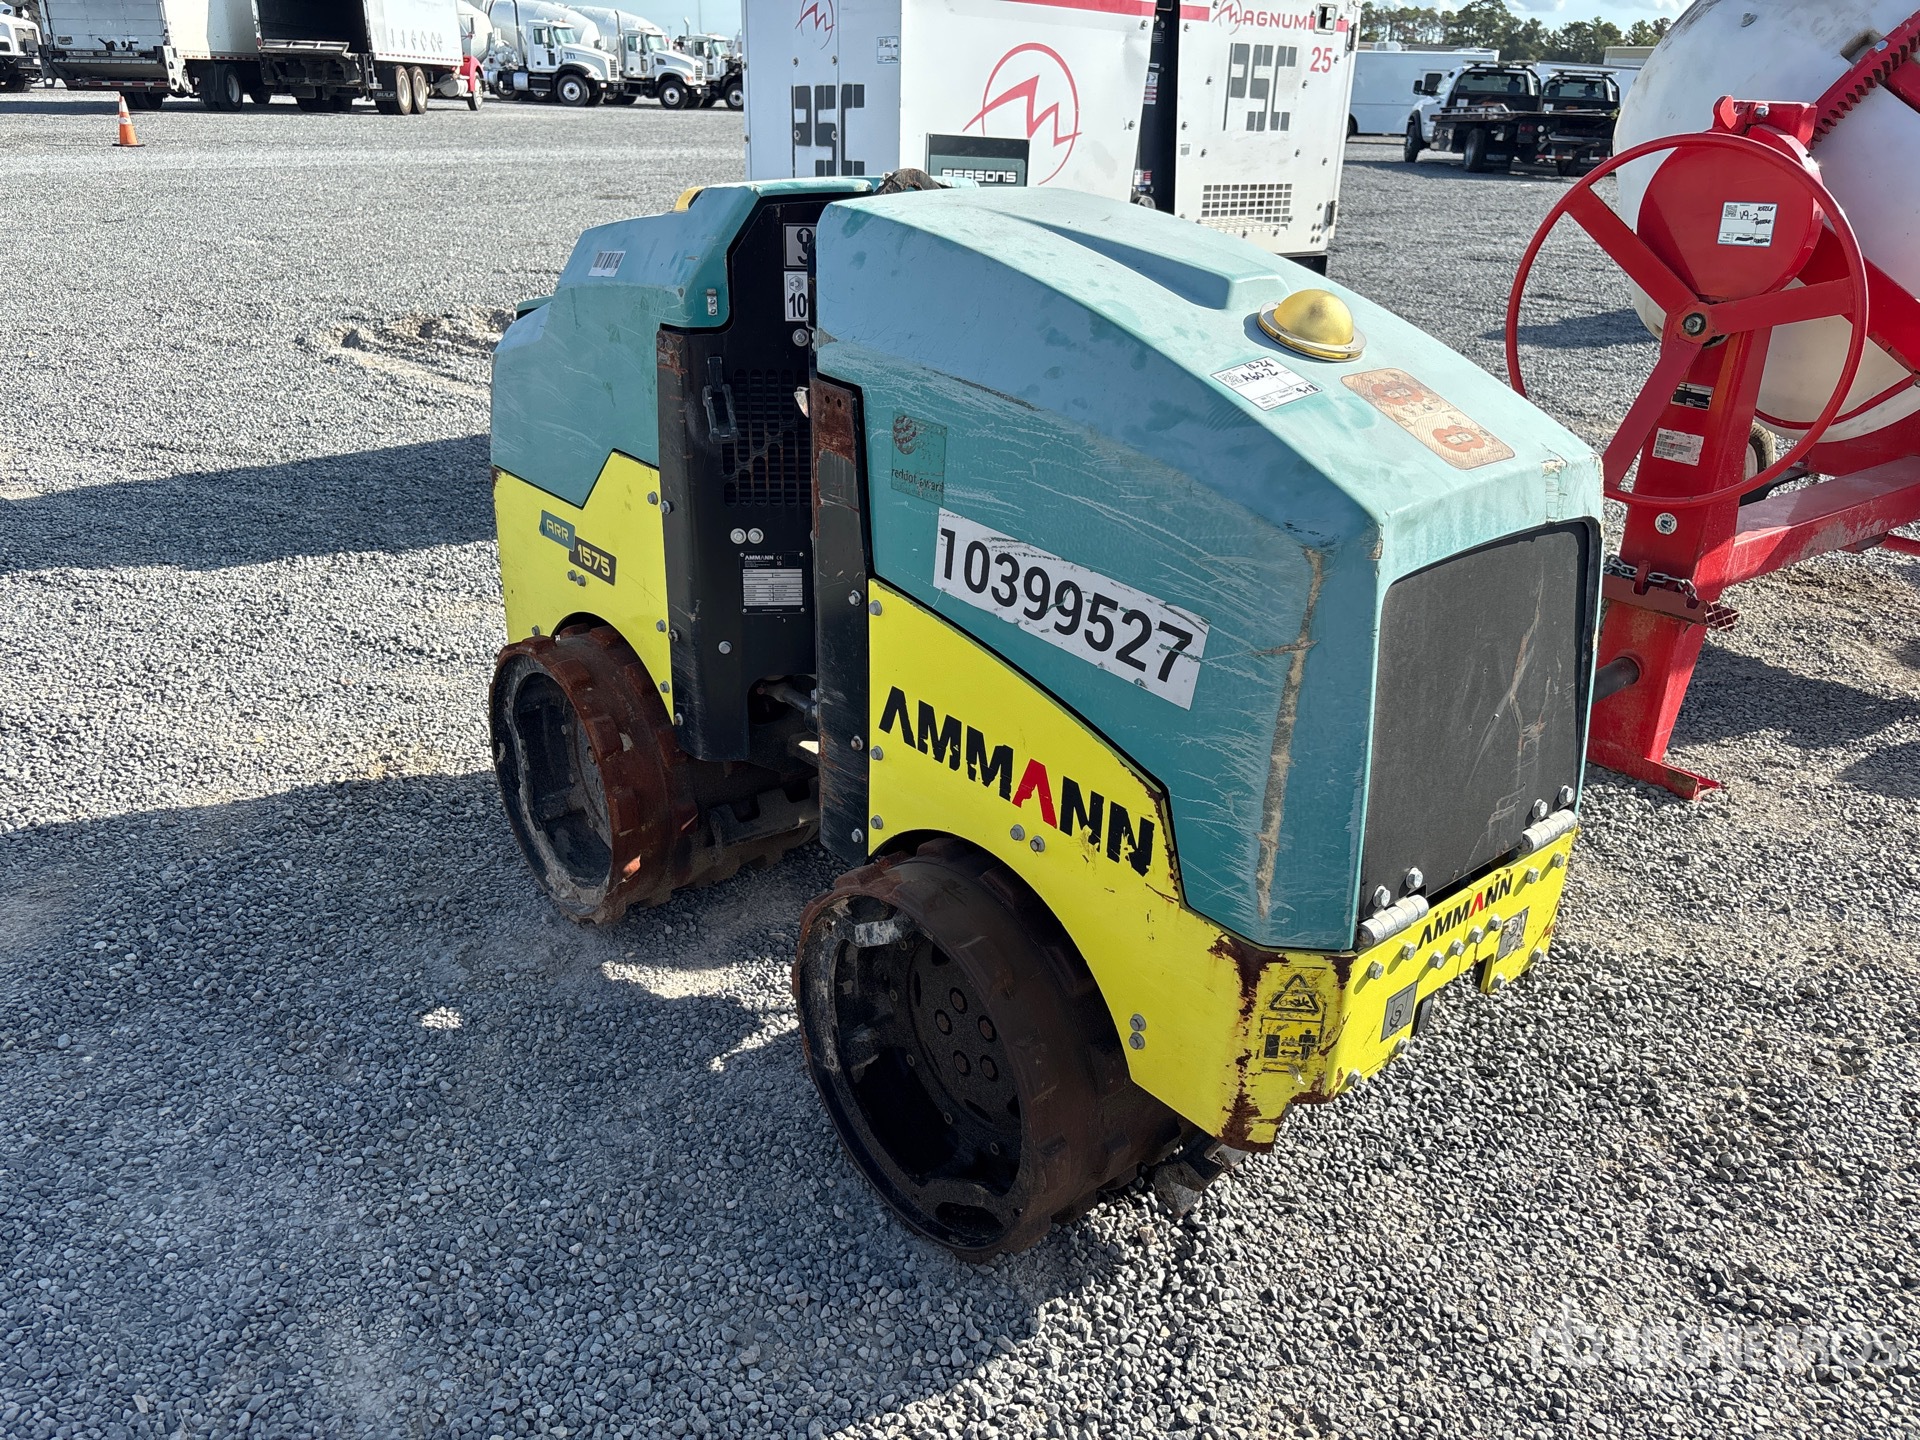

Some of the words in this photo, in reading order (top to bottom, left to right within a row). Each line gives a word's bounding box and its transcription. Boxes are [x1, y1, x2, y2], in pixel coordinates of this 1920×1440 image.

[1212, 3, 1308, 31] MAGNUM
[1222, 42, 1298, 132] PSC
[1309, 46, 1334, 74] 25
[790, 83, 866, 177] PSC
[788, 292, 807, 319] 10
[546, 518, 569, 542] ARR
[577, 543, 611, 577] 1575
[940, 527, 1194, 684] 10399527
[878, 685, 1156, 878] AMMANN
[1416, 873, 1514, 952] AMMANN
